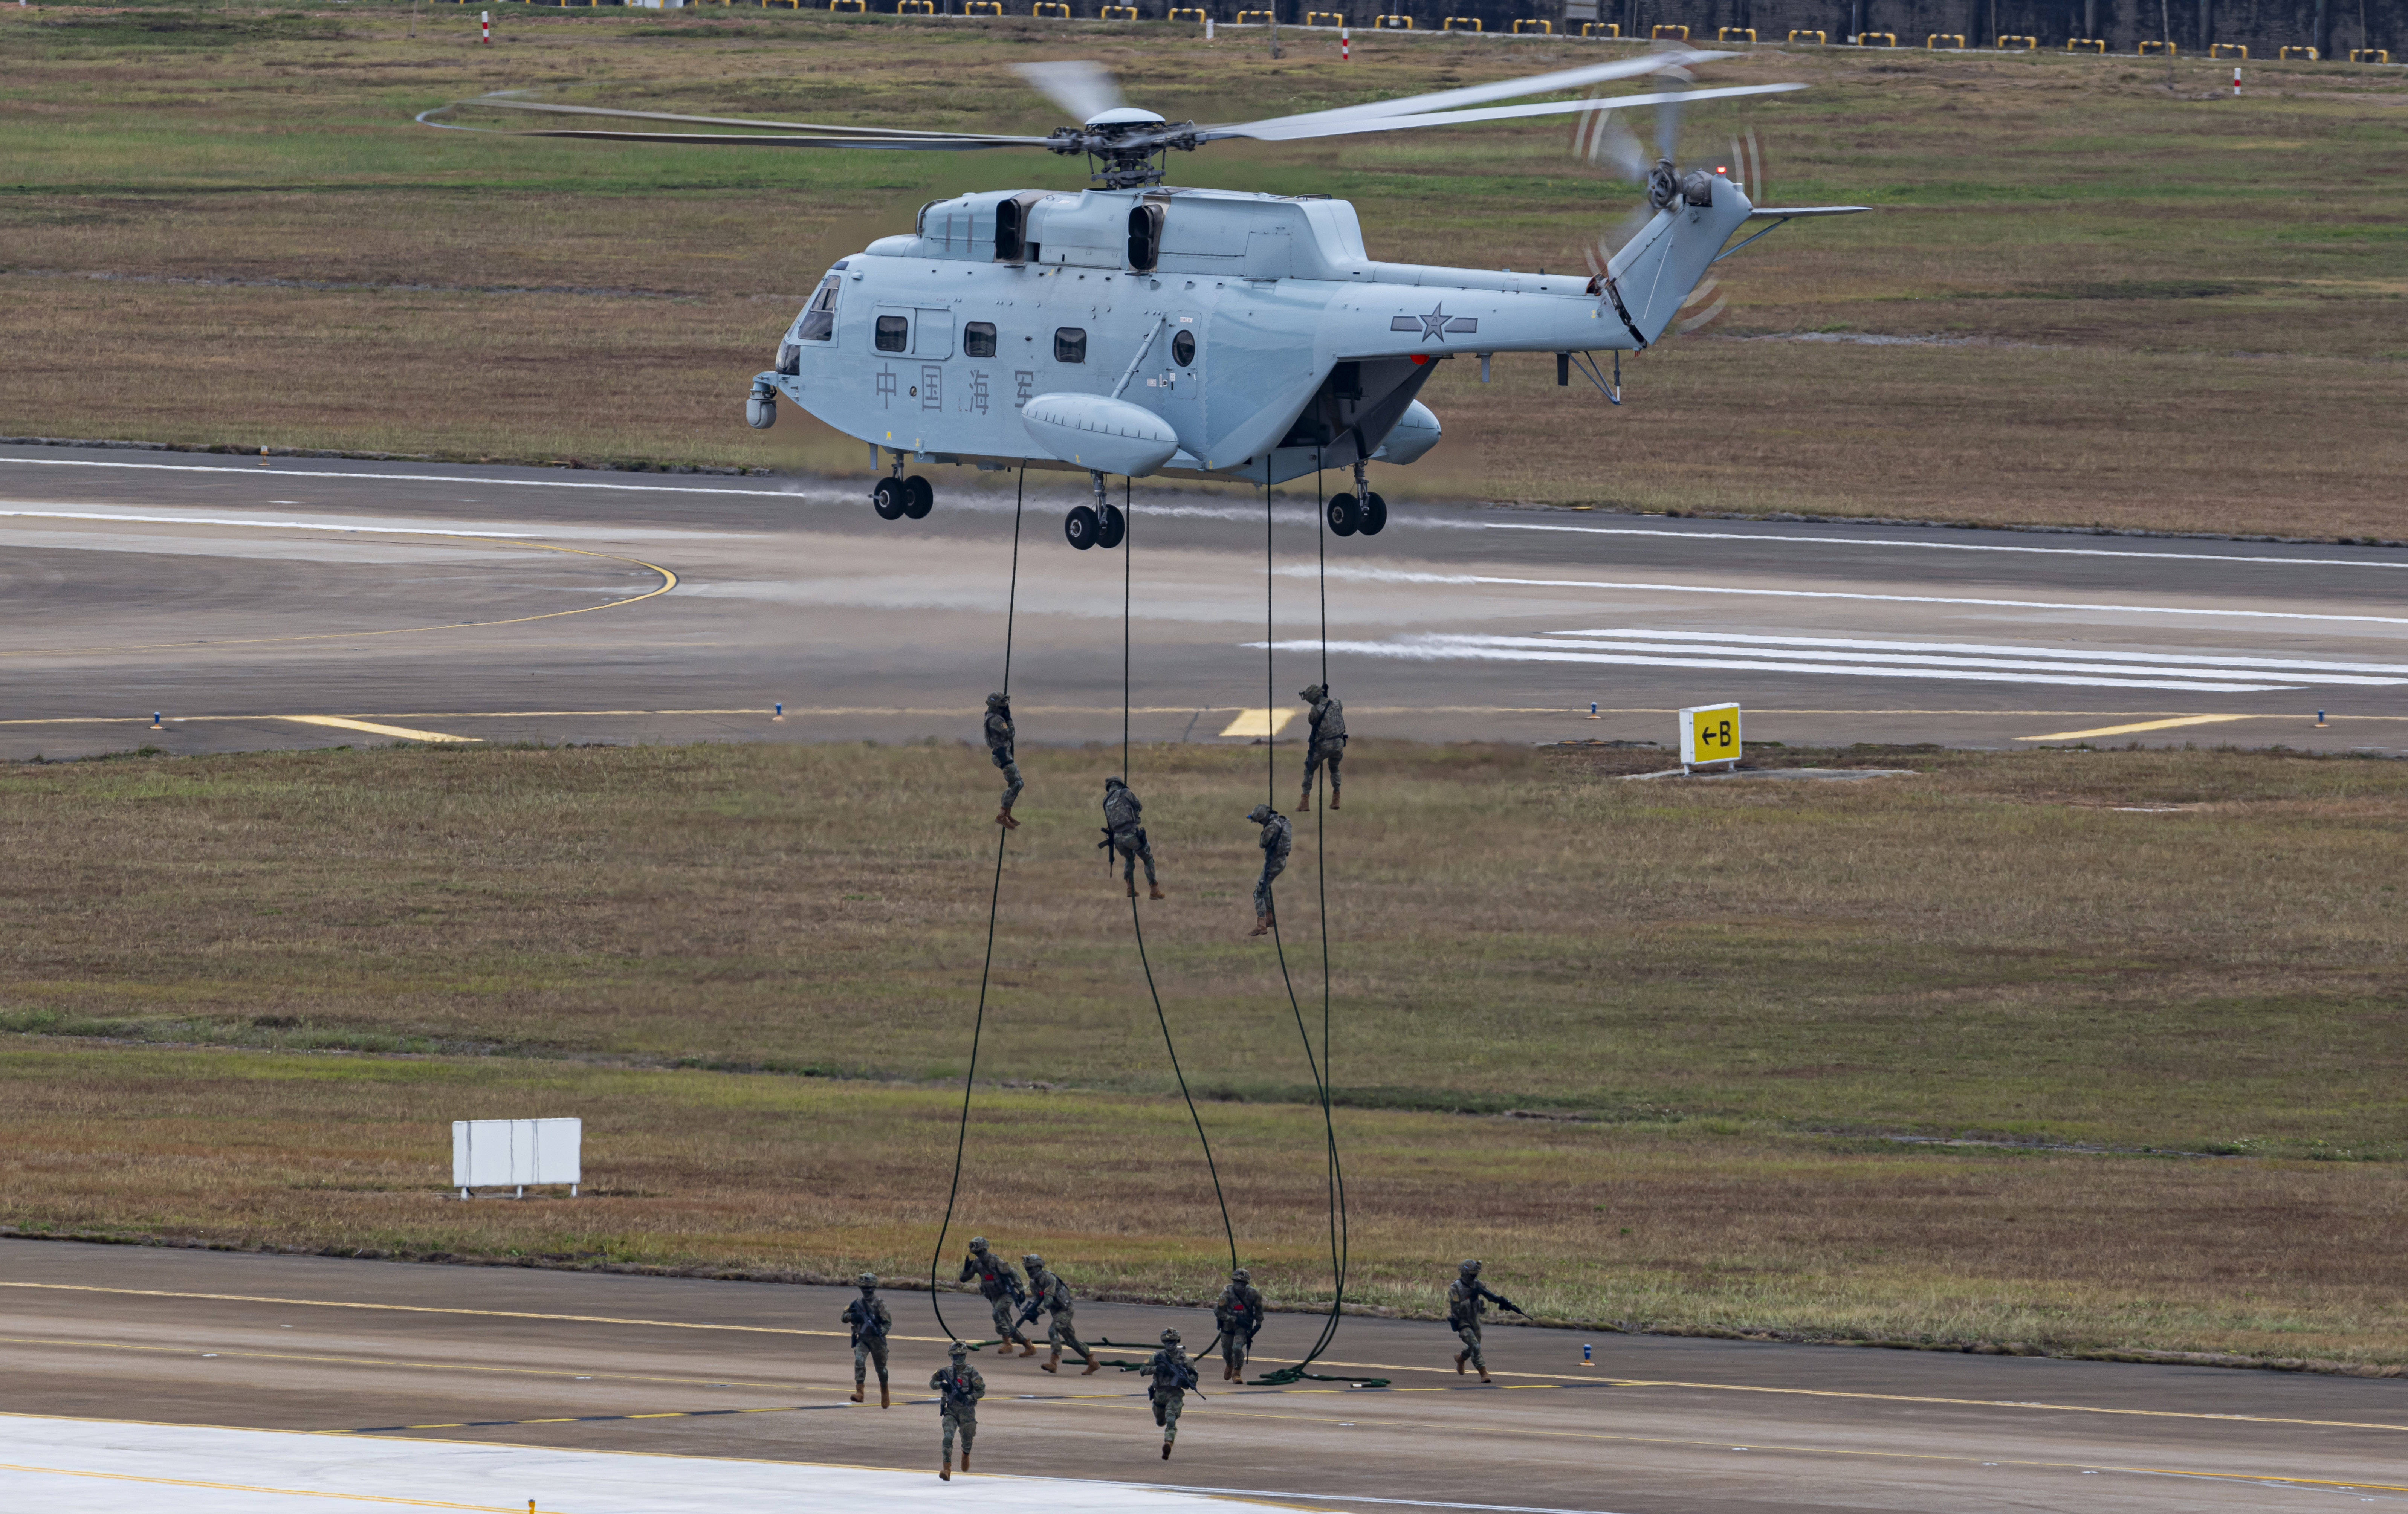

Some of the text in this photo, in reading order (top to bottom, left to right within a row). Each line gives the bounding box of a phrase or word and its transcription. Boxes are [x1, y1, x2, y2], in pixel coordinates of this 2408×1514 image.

[876, 362, 1033, 415] 中国海军
[1720, 720, 1731, 747] B
